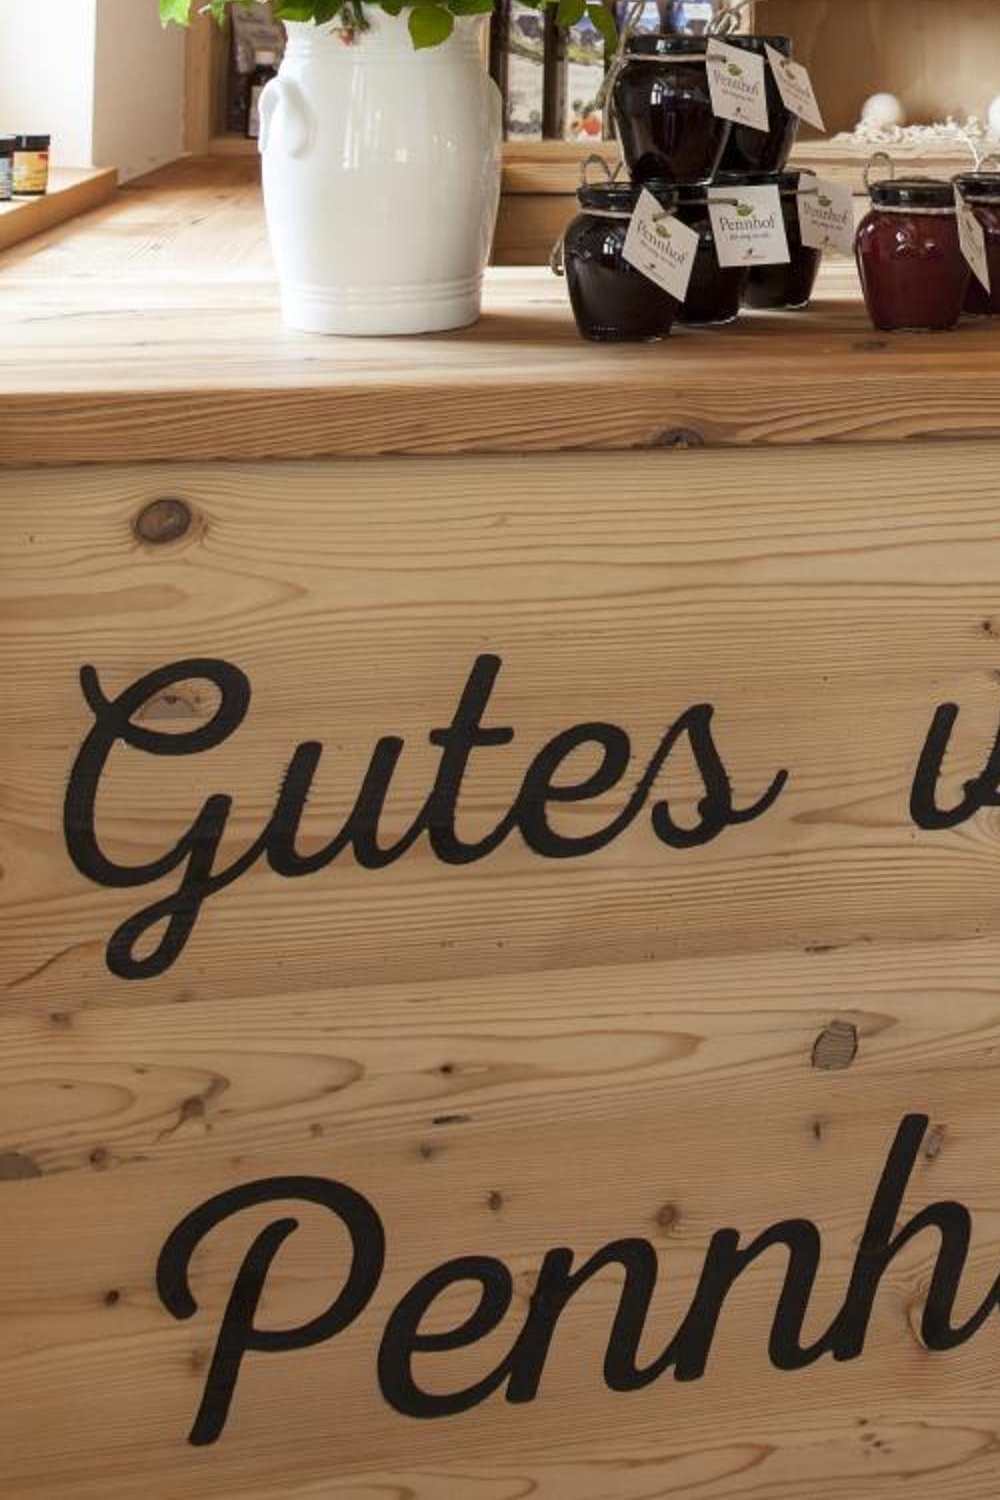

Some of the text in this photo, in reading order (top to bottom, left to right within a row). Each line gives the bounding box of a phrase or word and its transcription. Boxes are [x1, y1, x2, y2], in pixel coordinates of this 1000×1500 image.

[636, 218, 689, 265] Pennhof
[719, 211, 777, 232] Pennhof
[63, 653, 789, 981] Gutes
